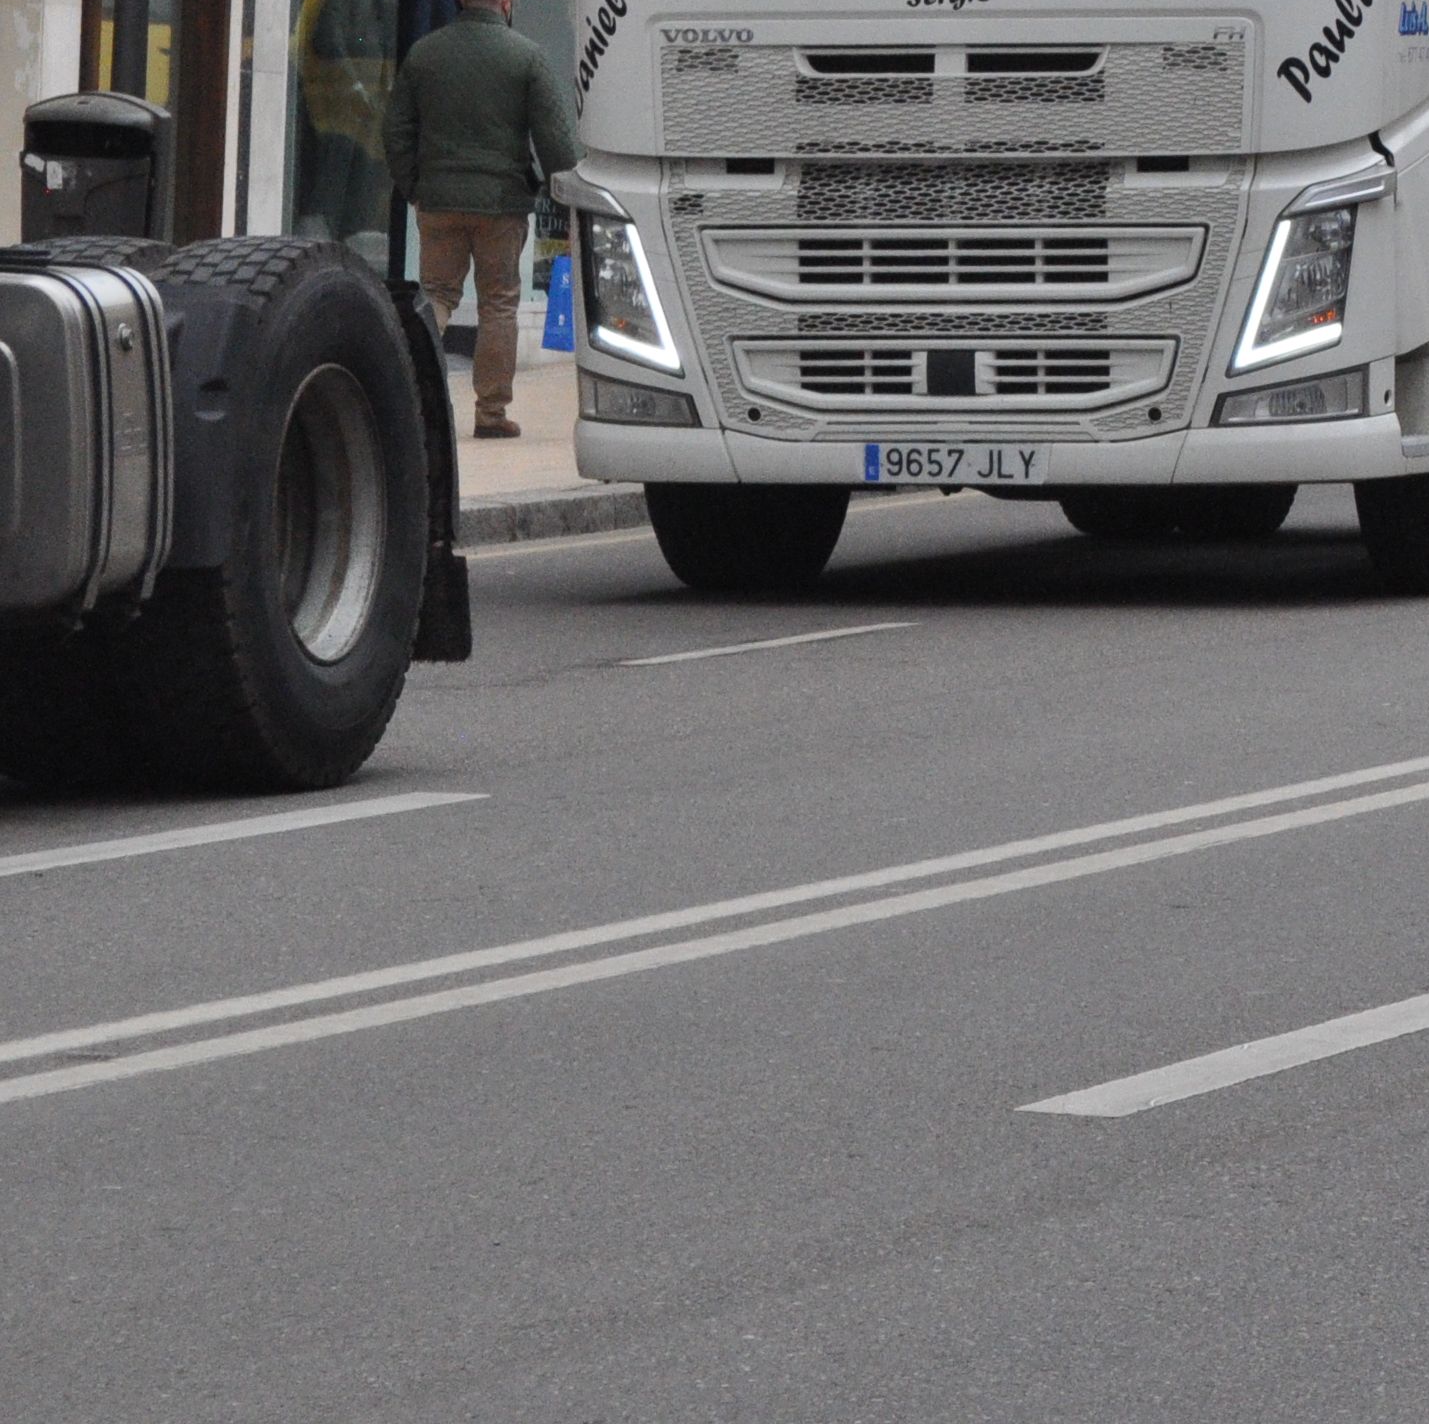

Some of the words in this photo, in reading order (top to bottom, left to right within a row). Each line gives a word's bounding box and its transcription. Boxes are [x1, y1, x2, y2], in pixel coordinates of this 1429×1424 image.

[660, 28, 754, 43] VOLVO
[1213, 26, 1247, 40] FH
[886, 448, 965, 478] 9657
[977, 449, 1035, 479] JLY
